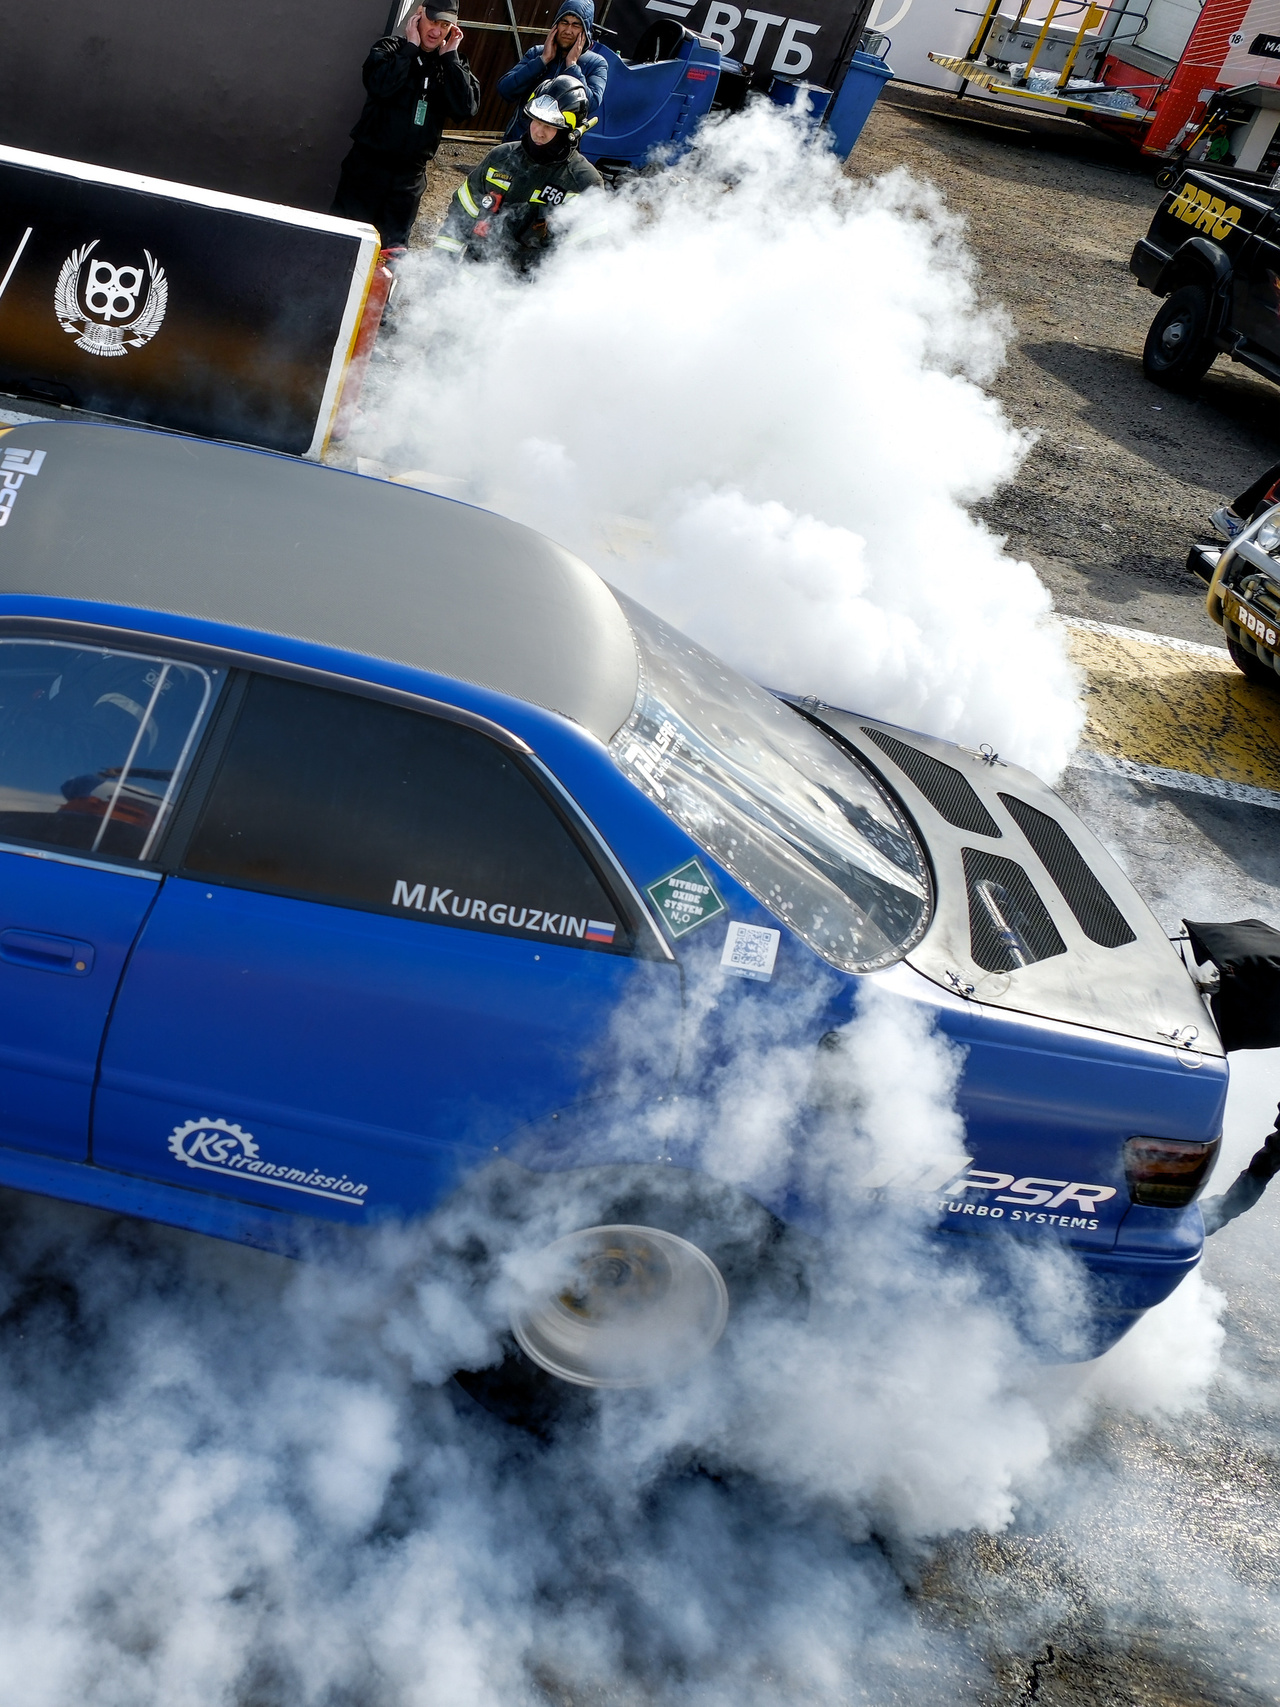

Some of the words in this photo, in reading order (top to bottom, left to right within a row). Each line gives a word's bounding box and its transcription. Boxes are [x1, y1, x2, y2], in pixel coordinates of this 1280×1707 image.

[700, 0, 822, 75] ВТБ
[540, 185, 564, 205] F56
[1167, 182, 1242, 241] RDRC
[1238, 605, 1277, 646] RDRC
[668, 877, 710, 895] NITROUS
[672, 889, 702, 904] OXIDE
[663, 898, 704, 916] SYSTEM
[943, 1169, 1118, 1213] PSR
[937, 1200, 1004, 1219] TURBO
[1010, 1210, 1100, 1231] SYSTEMS
